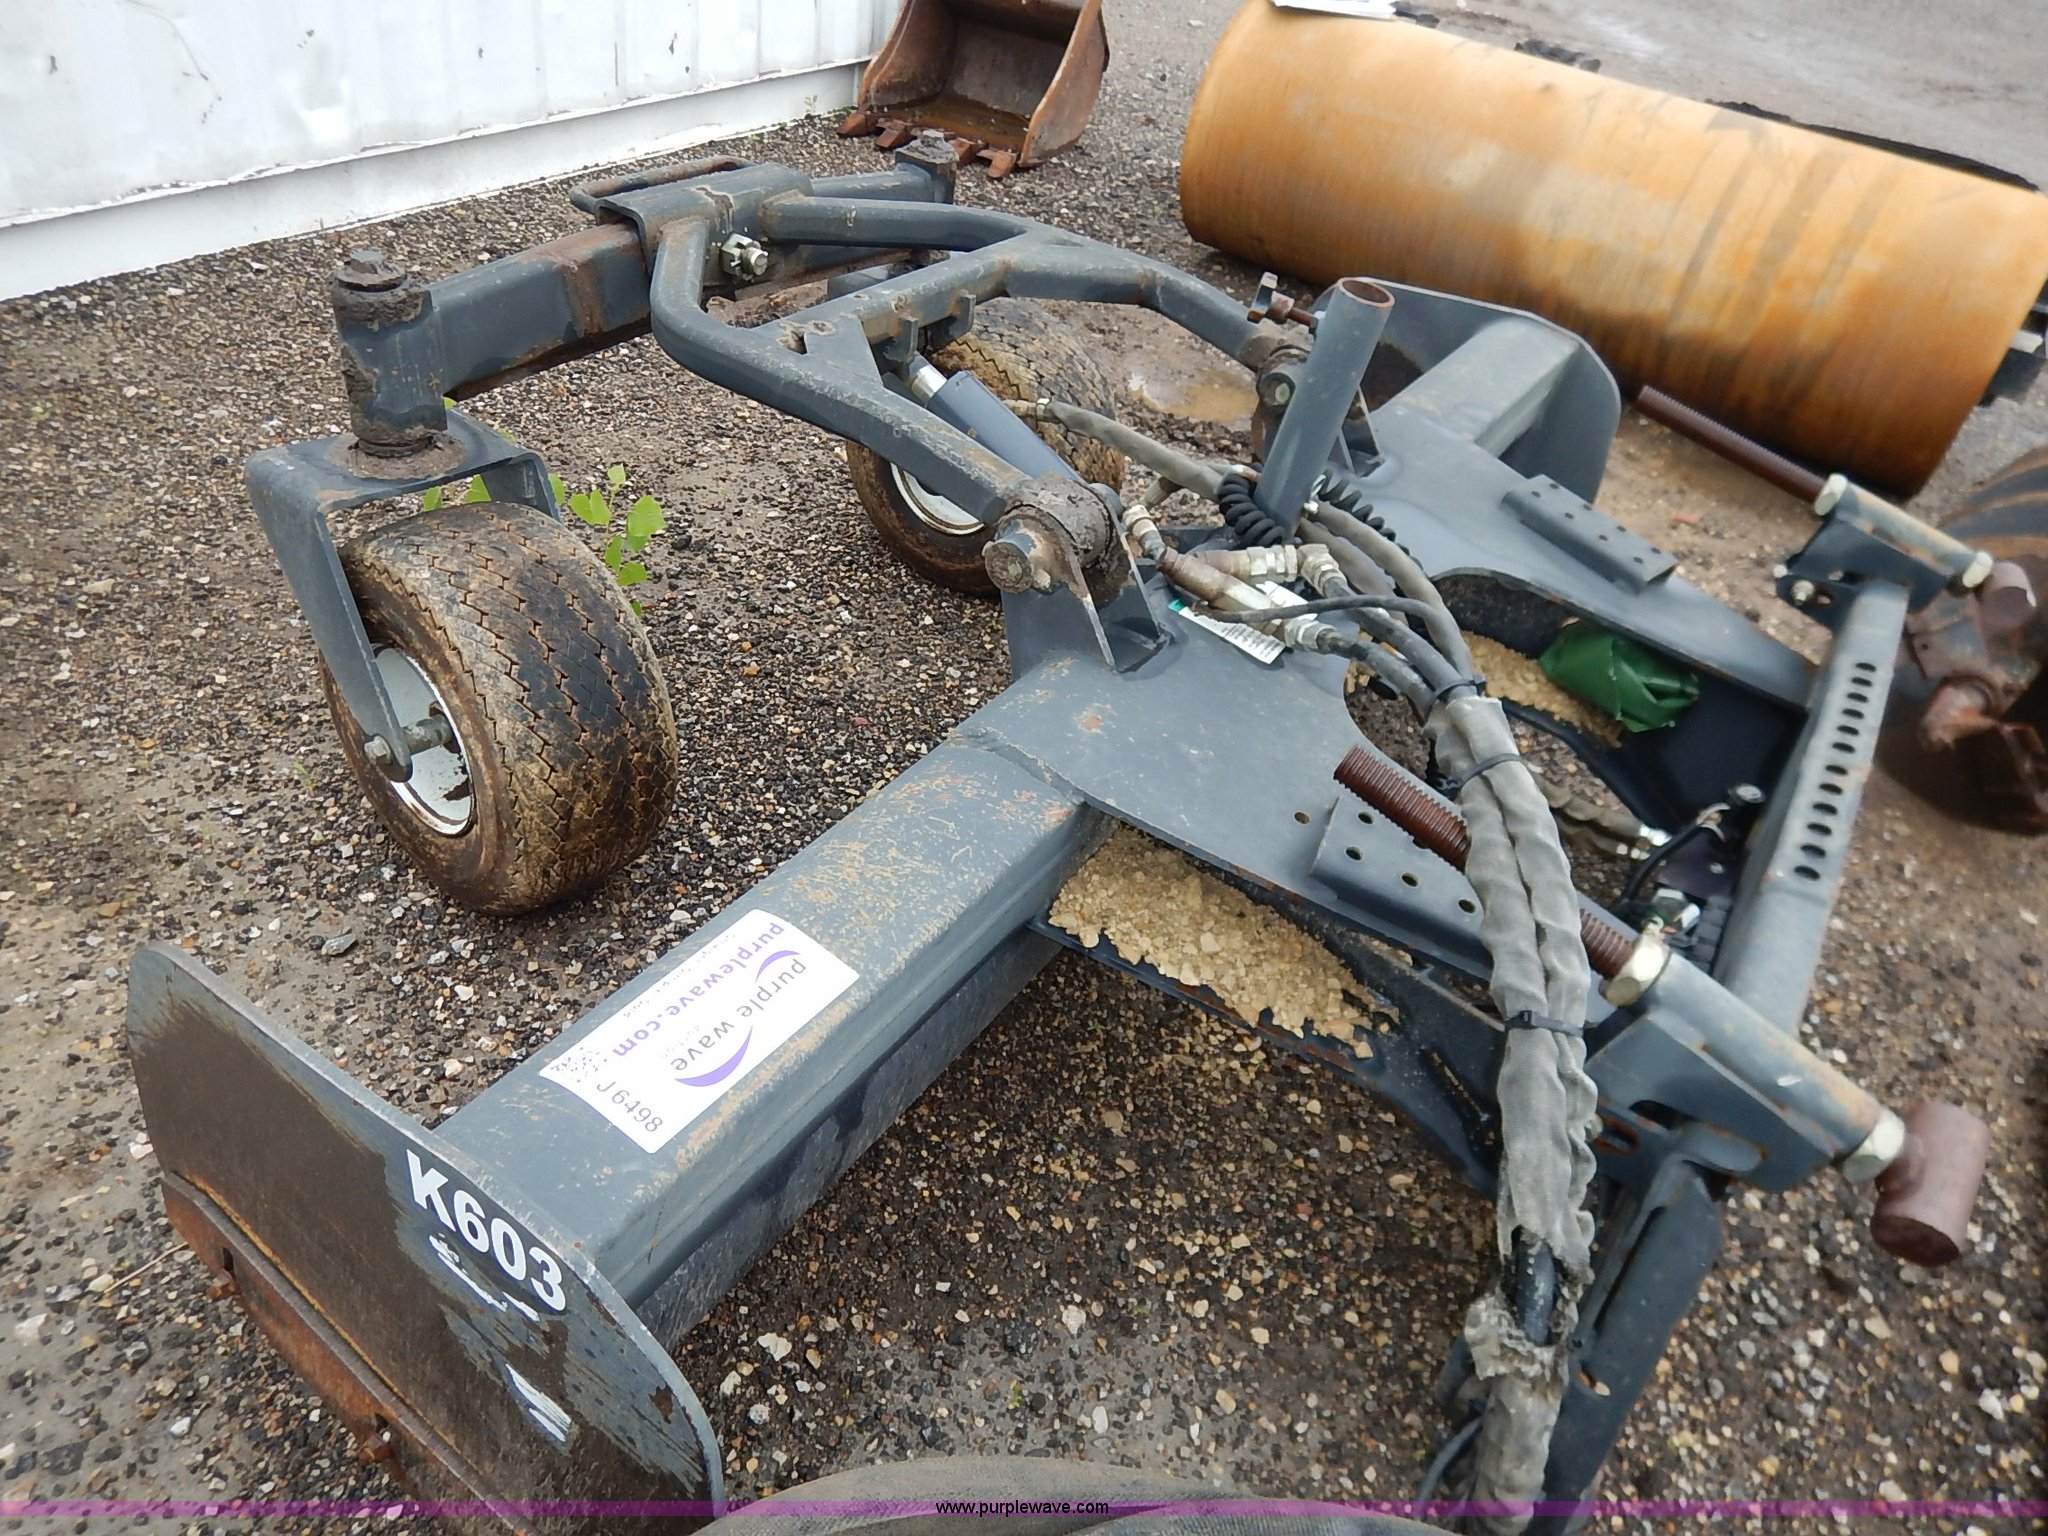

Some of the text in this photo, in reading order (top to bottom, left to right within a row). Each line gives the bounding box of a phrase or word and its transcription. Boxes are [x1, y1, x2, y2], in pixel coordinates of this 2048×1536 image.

[612, 922, 785, 1056] purplewave.com
[736, 958, 807, 1018] purple
[670, 1021, 735, 1071] wave
[406, 1149, 566, 1311] K603
